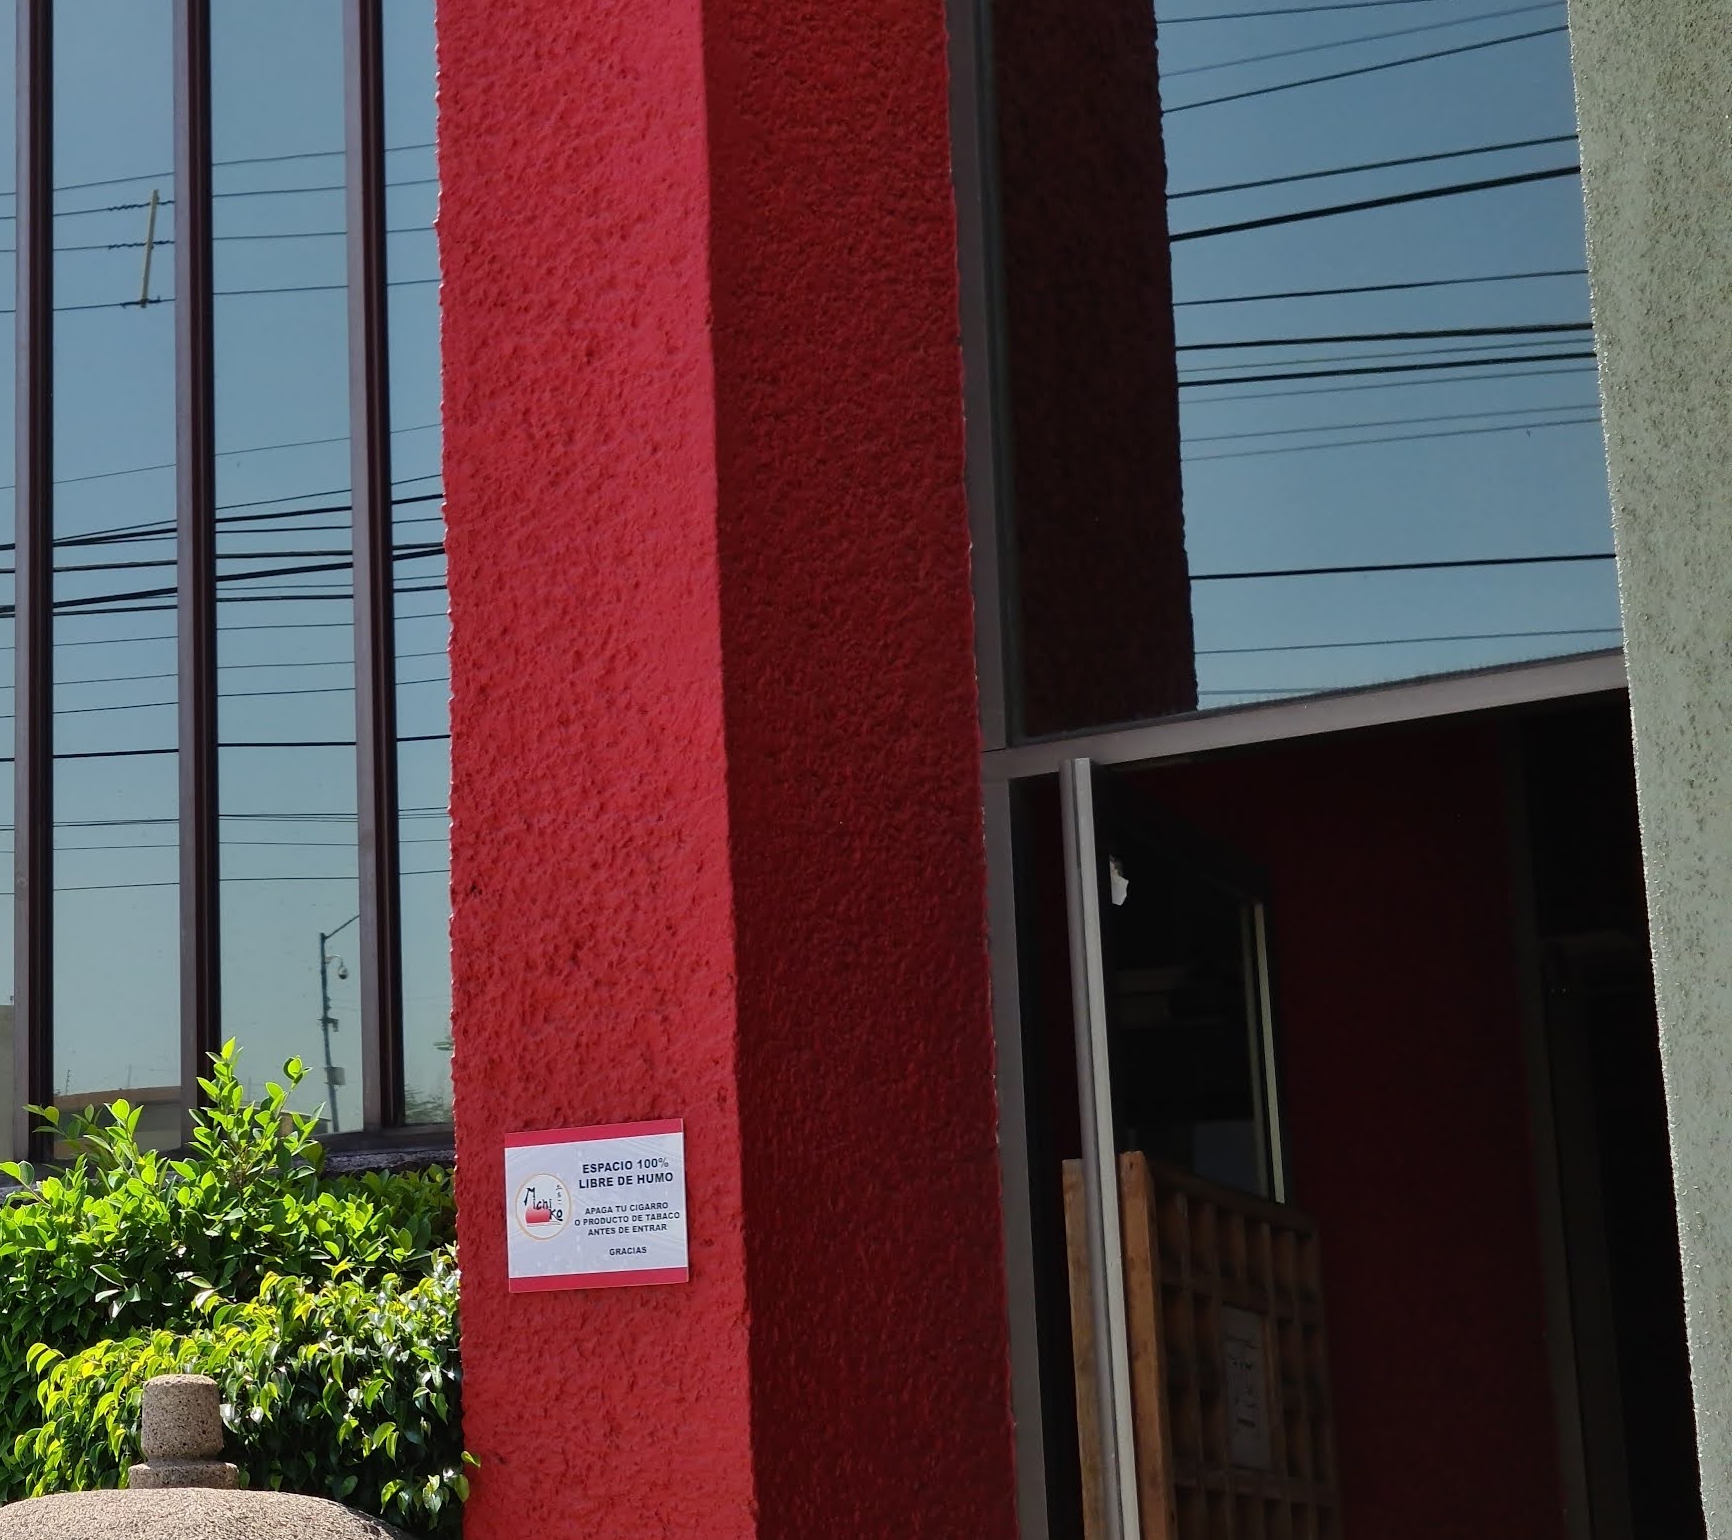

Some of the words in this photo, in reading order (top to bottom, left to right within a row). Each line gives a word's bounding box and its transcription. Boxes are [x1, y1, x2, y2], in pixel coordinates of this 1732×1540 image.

[582, 1160, 633, 1174] ESPACIO
[637, 1157, 669, 1169] 100%
[578, 1177, 614, 1189] LIBRE
[617, 1175, 633, 1186] DE
[637, 1172, 674, 1184] HUMO
[523, 1186, 553, 1211] Michi
[584, 1206, 614, 1215] APAGA
[615, 1204, 627, 1213] TU
[629, 1201, 669, 1212] CIGARRO
[583, 1215, 629, 1226] PRODUCTO
[631, 1214, 643, 1222] DE
[645, 1211, 680, 1221] TABACO
[587, 1227, 616, 1236] ANTES
[618, 1226, 630, 1234] DE
[632, 1223, 668, 1233] ENTRAR
[609, 1246, 648, 1256] GRACIAS
